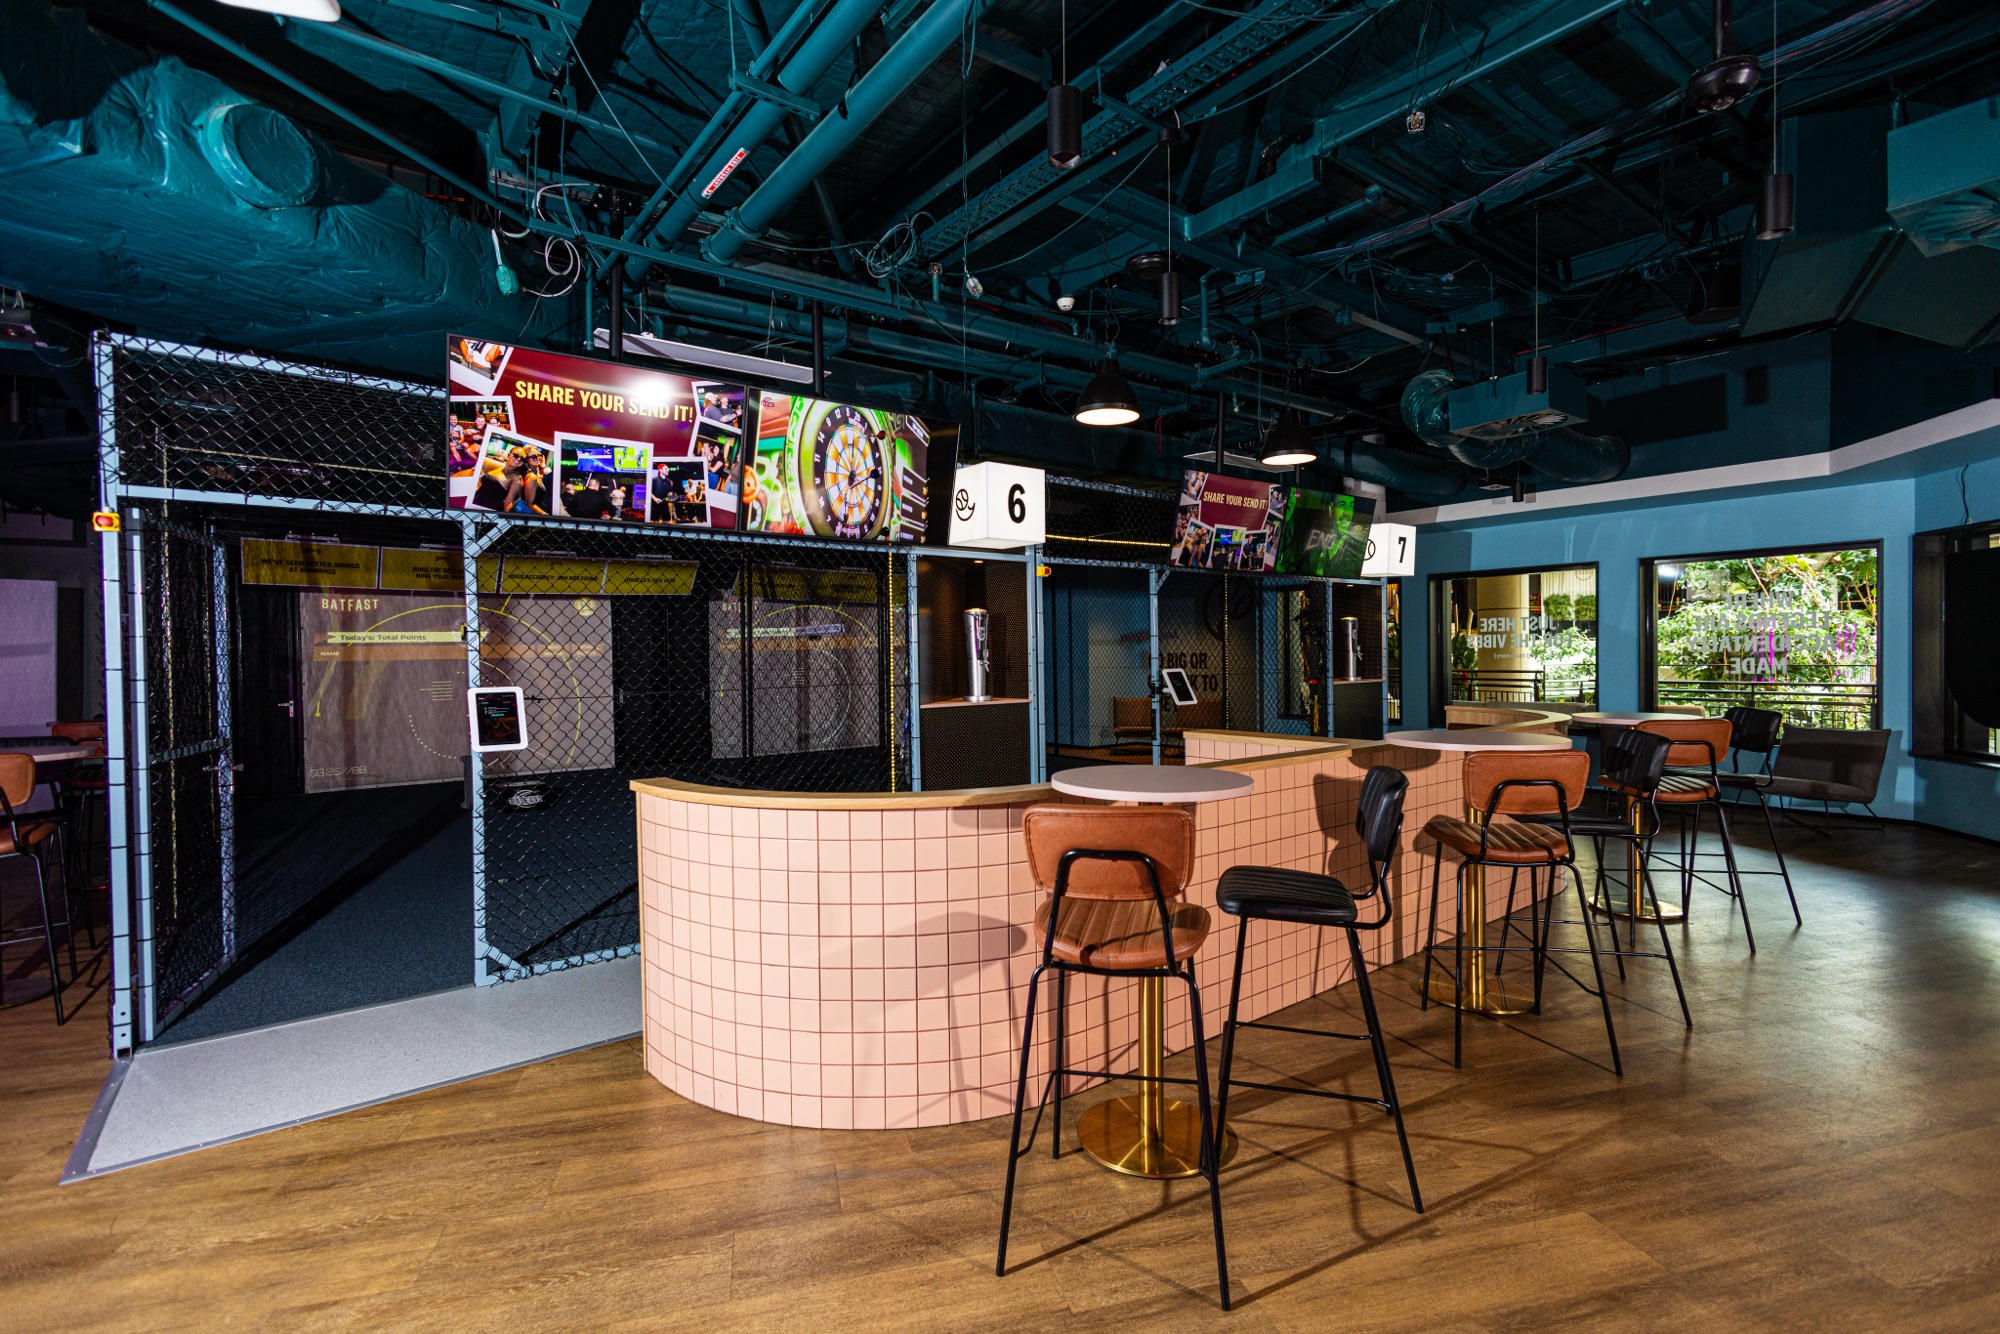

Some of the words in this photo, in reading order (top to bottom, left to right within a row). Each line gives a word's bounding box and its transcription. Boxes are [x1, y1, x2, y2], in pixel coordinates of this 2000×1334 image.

[515, 380, 575, 406] SHARE
[579, 390, 625, 413] YOUR
[628, 396, 670, 422] SEND
[673, 404, 694, 424] IT!
[834, 408, 841, 420] 12
[826, 417, 832, 427] 9
[818, 431, 825, 443] 14
[814, 453, 821, 463] 11
[1008, 483, 1026, 524] 6
[1203, 491, 1225, 504] SHARE
[1226, 494, 1243, 507] YOUR
[1243, 497, 1259, 509] SEND
[1260, 499, 1268, 510] IT!
[1398, 537, 1407, 563] 7
[261, 558, 284, 567] WE'VE
[322, 598, 379, 612] BATFAST
[340, 634, 375, 642] Today's:
[1167, 652, 1187, 669] BIG
[1190, 652, 1208, 670] OR
[1201, 674, 1219, 692] TO
